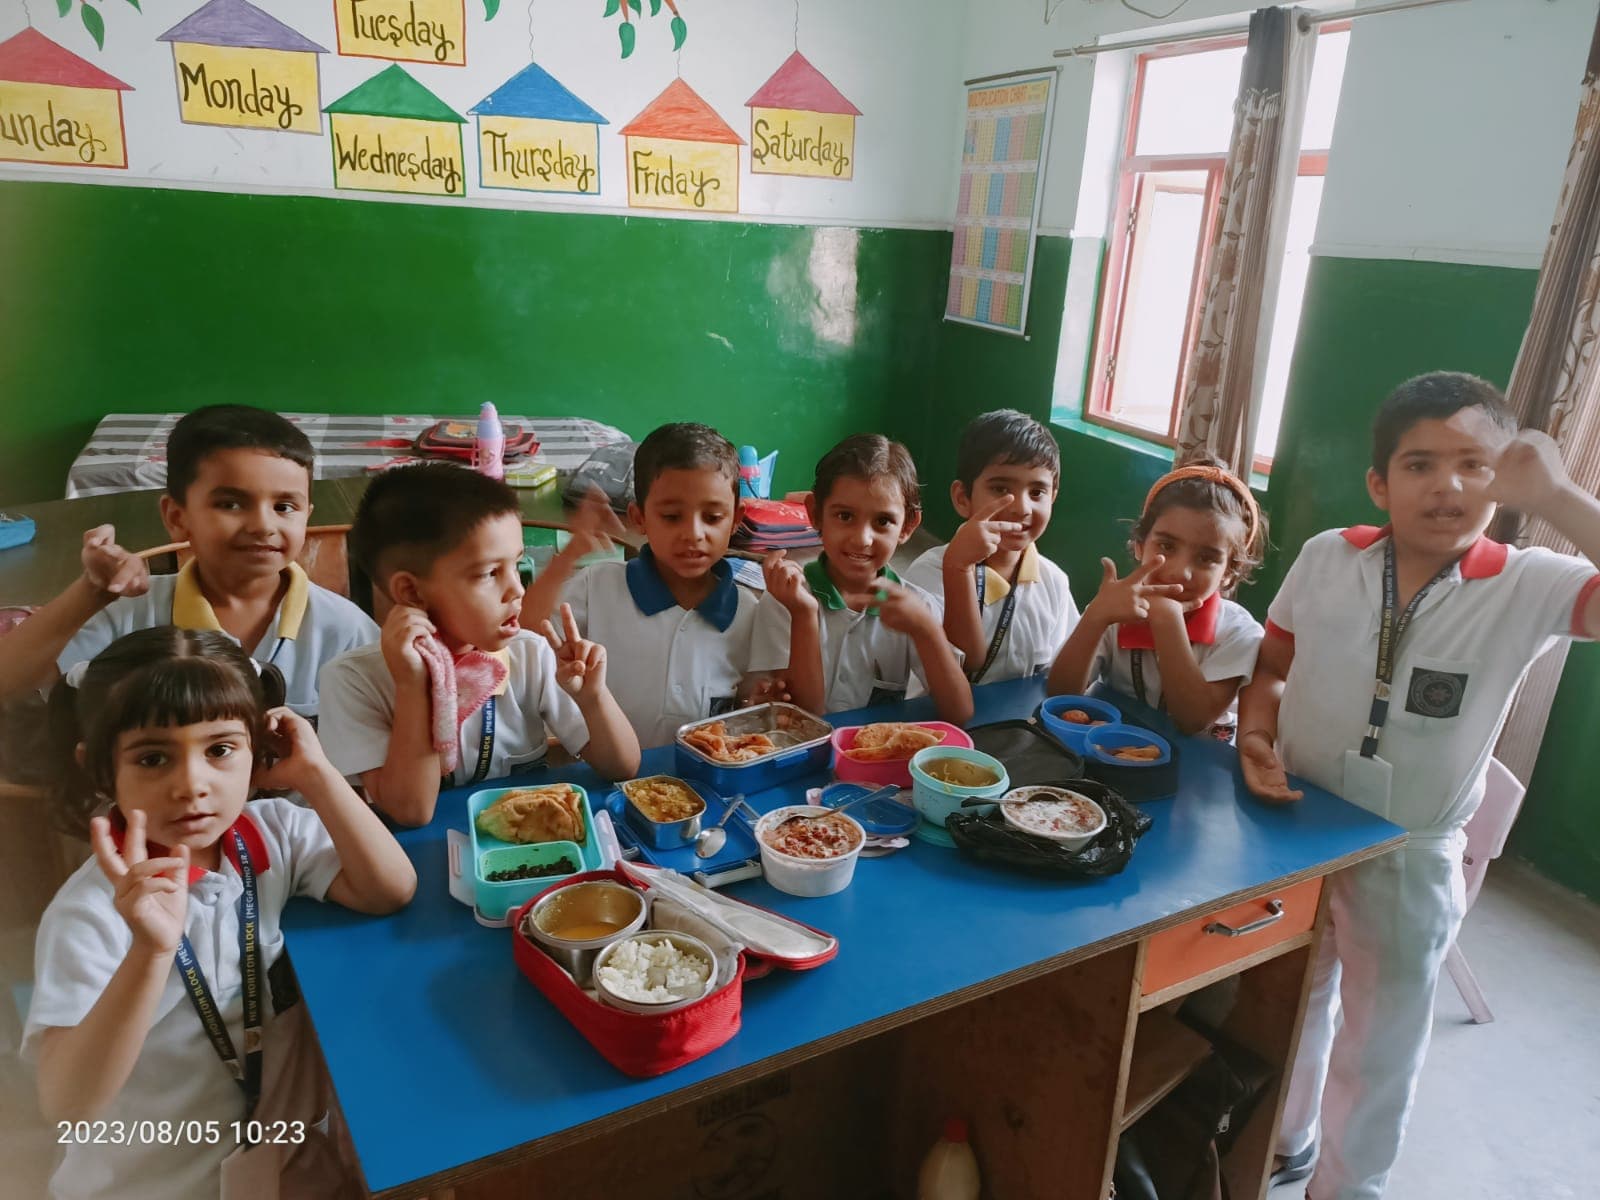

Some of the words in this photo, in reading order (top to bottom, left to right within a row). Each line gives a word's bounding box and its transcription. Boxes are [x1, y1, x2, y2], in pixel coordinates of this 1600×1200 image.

[349, 0, 455, 62] Tuesday
[179, 62, 303, 130] Monday
[0, 99, 107, 163] unday
[752, 119, 849, 176] Saturday
[335, 133, 461, 193] Wednesday
[482, 129, 596, 193] Thursday
[632, 151, 721, 208] Friday
[177, 942, 193, 967] (MEG
[245, 921, 255, 952] BLOCK
[185, 965, 204, 998] BLOCK
